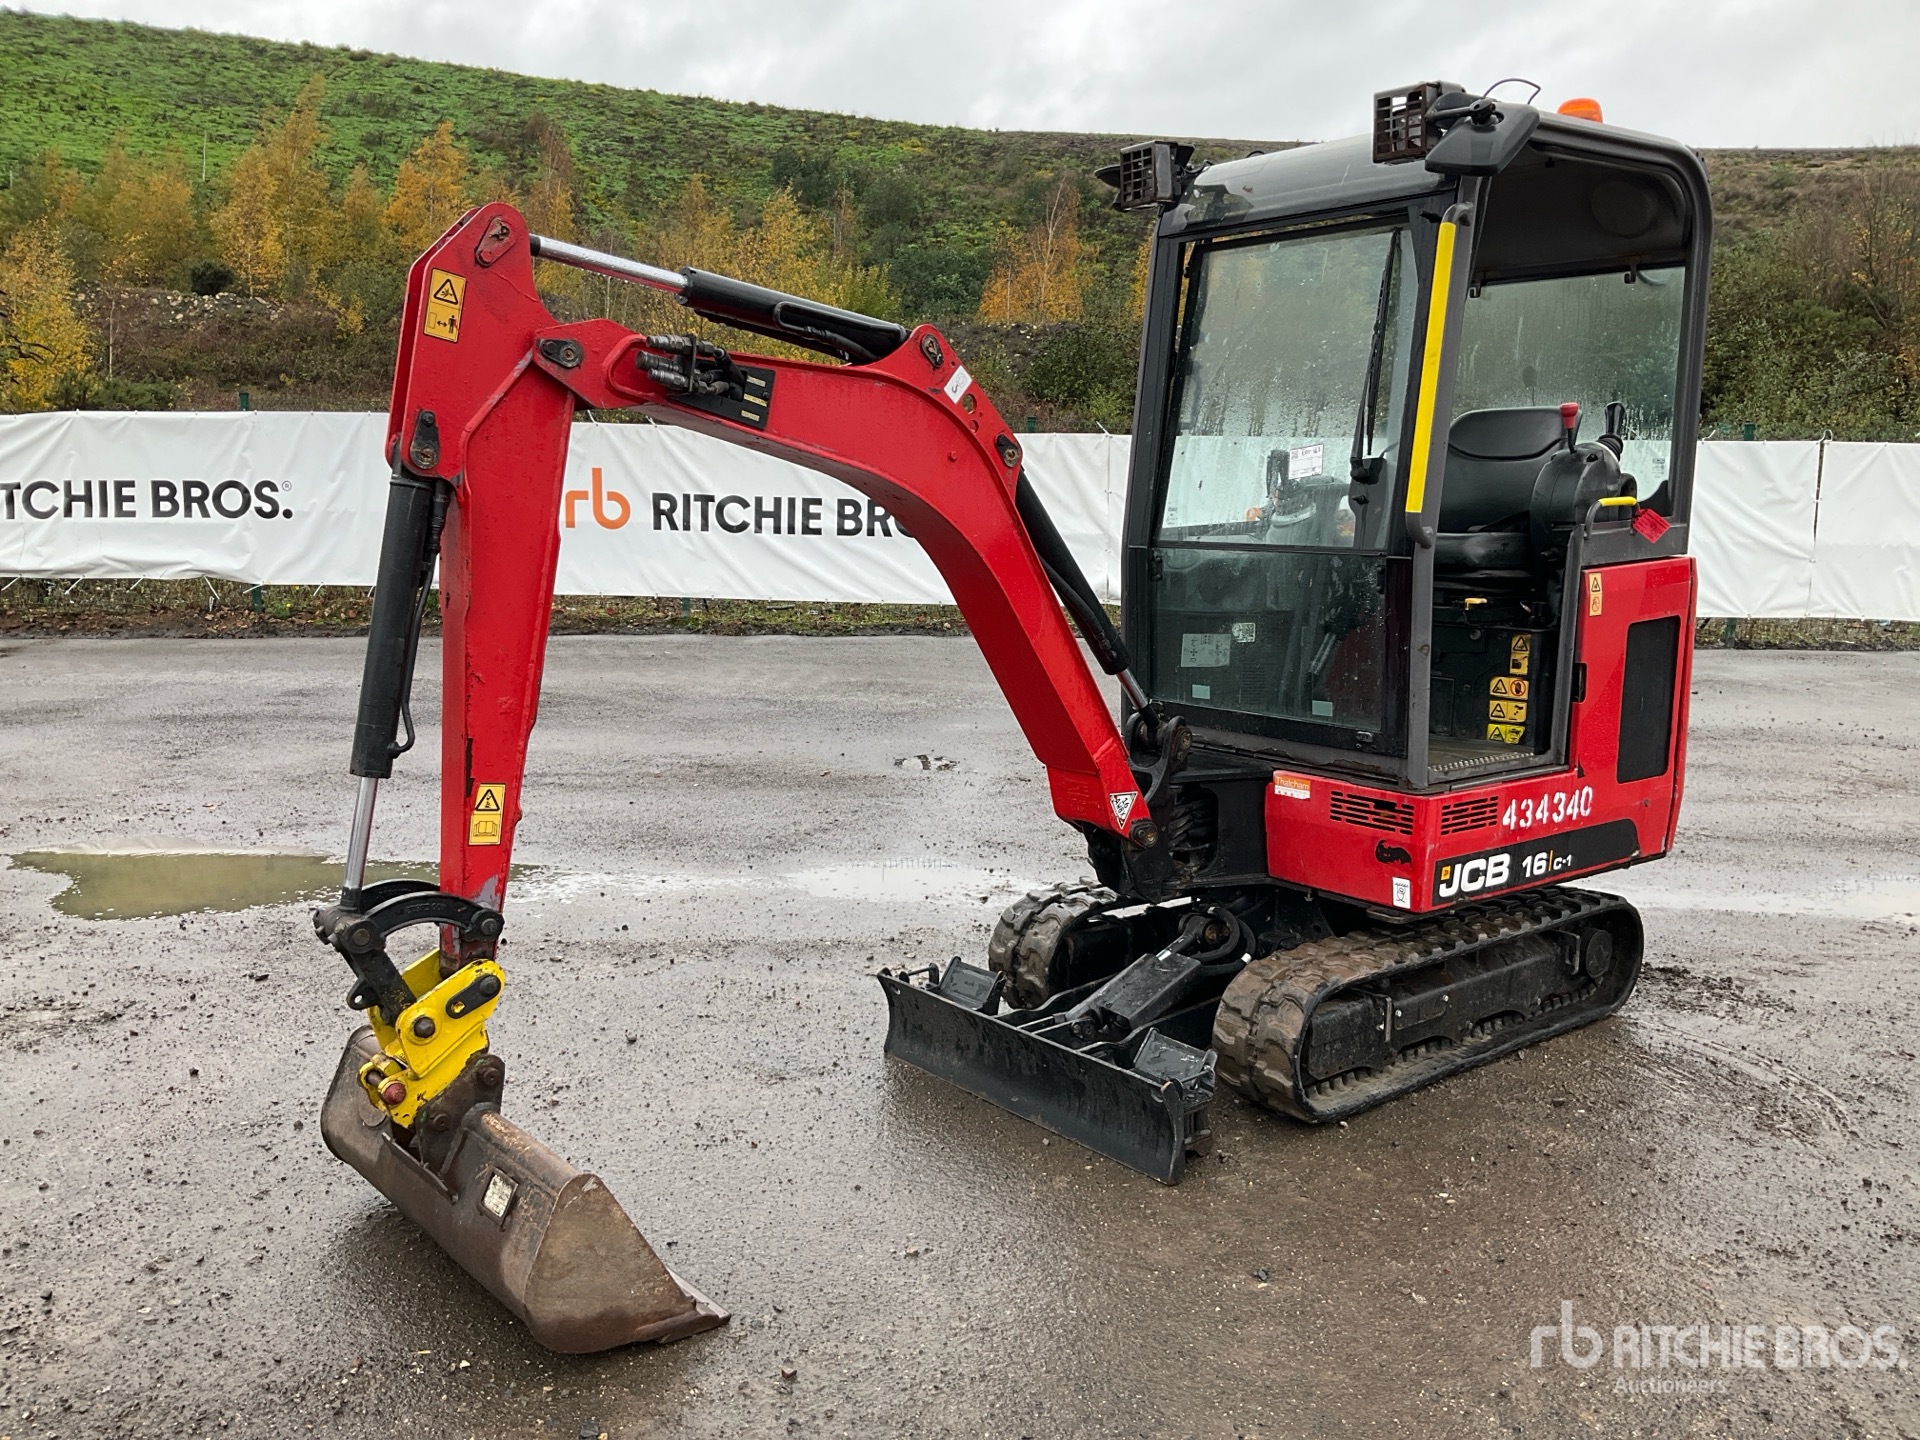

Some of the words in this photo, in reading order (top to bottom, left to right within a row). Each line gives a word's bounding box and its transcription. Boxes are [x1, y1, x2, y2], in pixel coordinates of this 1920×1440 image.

[565, 467, 631, 530] rb
[652, 492, 822, 535] RITCHIE
[836, 498, 914, 538] BR
[1275, 776, 1309, 790] Thatcham
[1502, 786, 1593, 830] 434340
[1439, 853, 1511, 897] JCB
